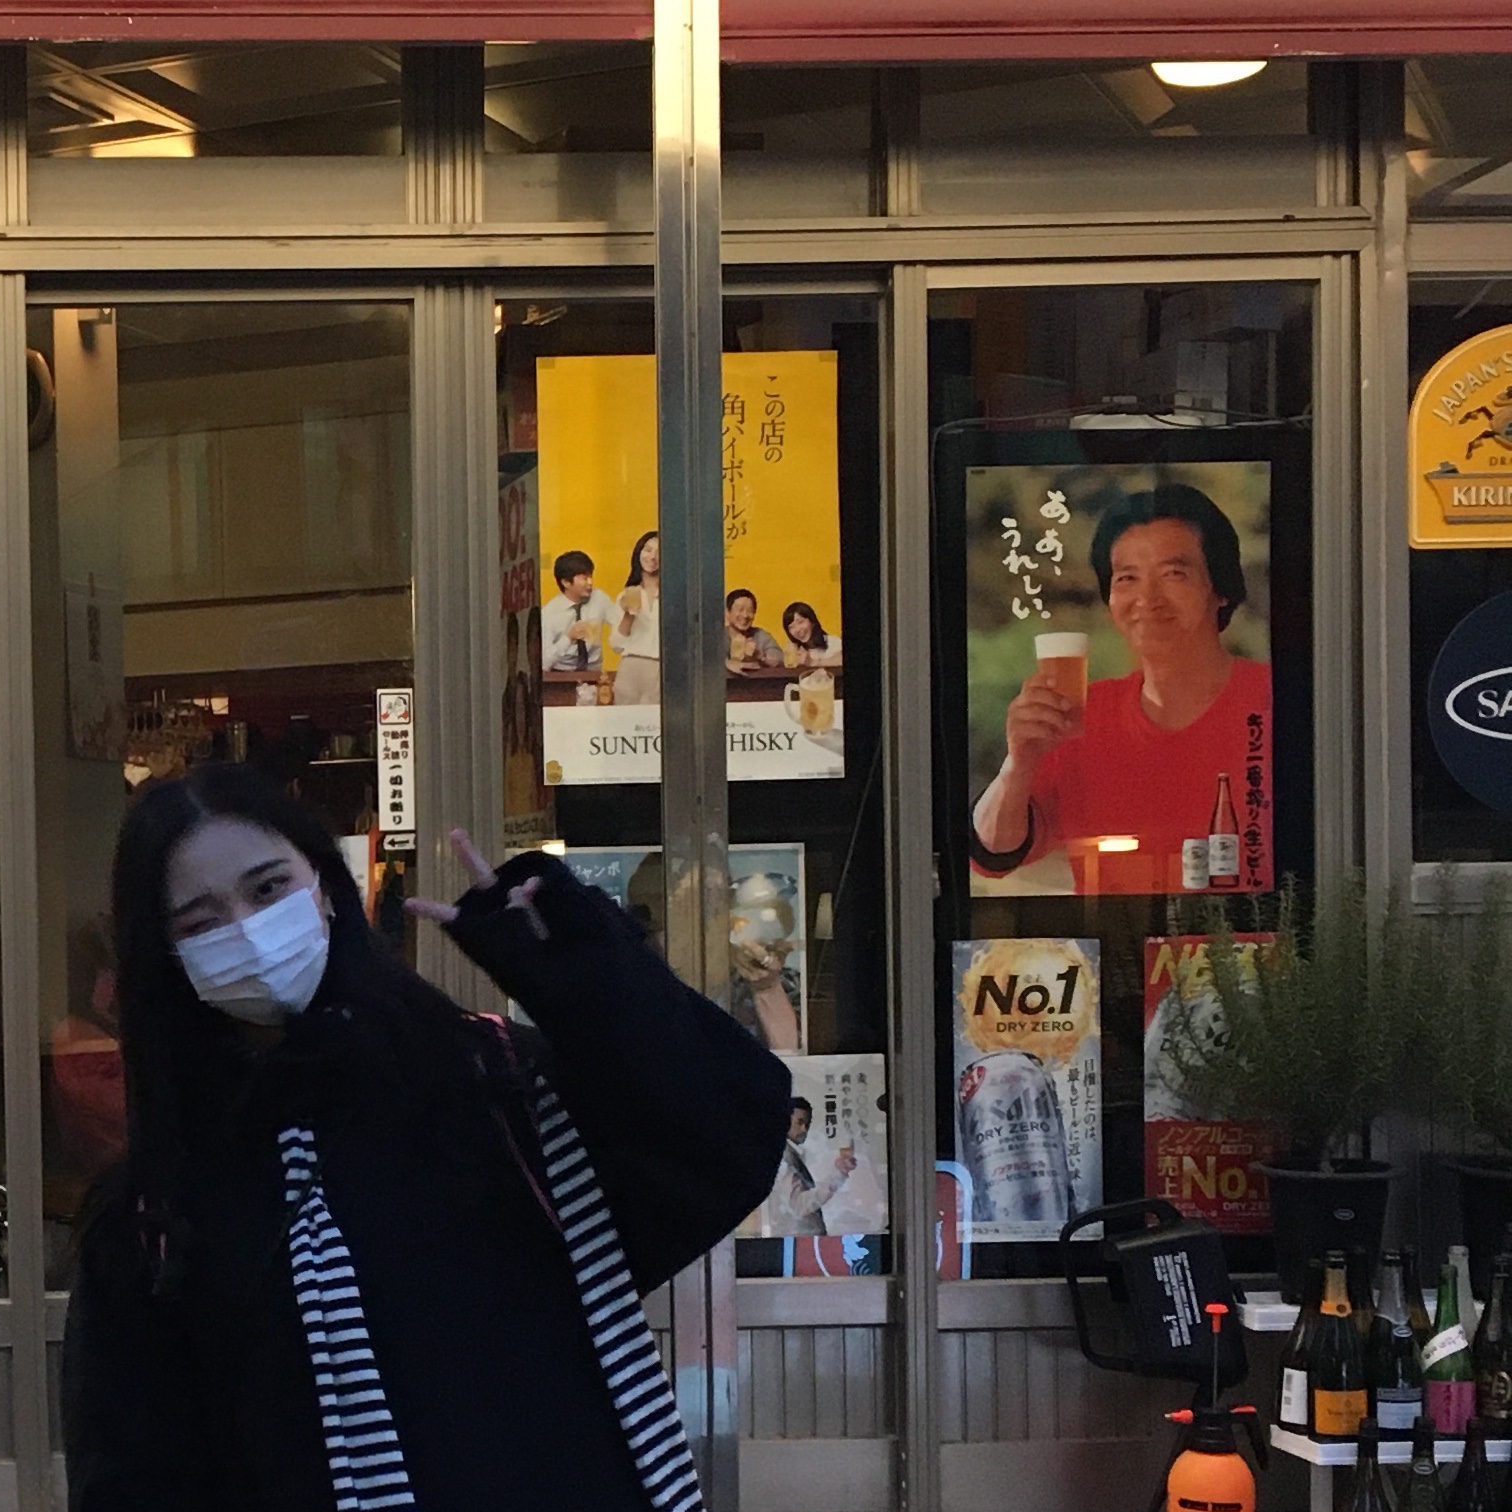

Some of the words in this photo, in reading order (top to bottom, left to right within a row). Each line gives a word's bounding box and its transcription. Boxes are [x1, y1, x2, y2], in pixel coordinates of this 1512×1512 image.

[759, 375, 785, 463] この店の
[722, 392, 747, 541] 角ハイボールが
[726, 732, 798, 752] HISKY
[974, 965, 1081, 1015] No.1
[996, 1022, 1026, 1033] DRY
[1031, 1021, 1075, 1032] ZERO
[1008, 1121, 1051, 1134] ZERO
[1157, 1126, 1257, 1144] ノンアルコー
[1182, 1155, 1270, 1200] No.
